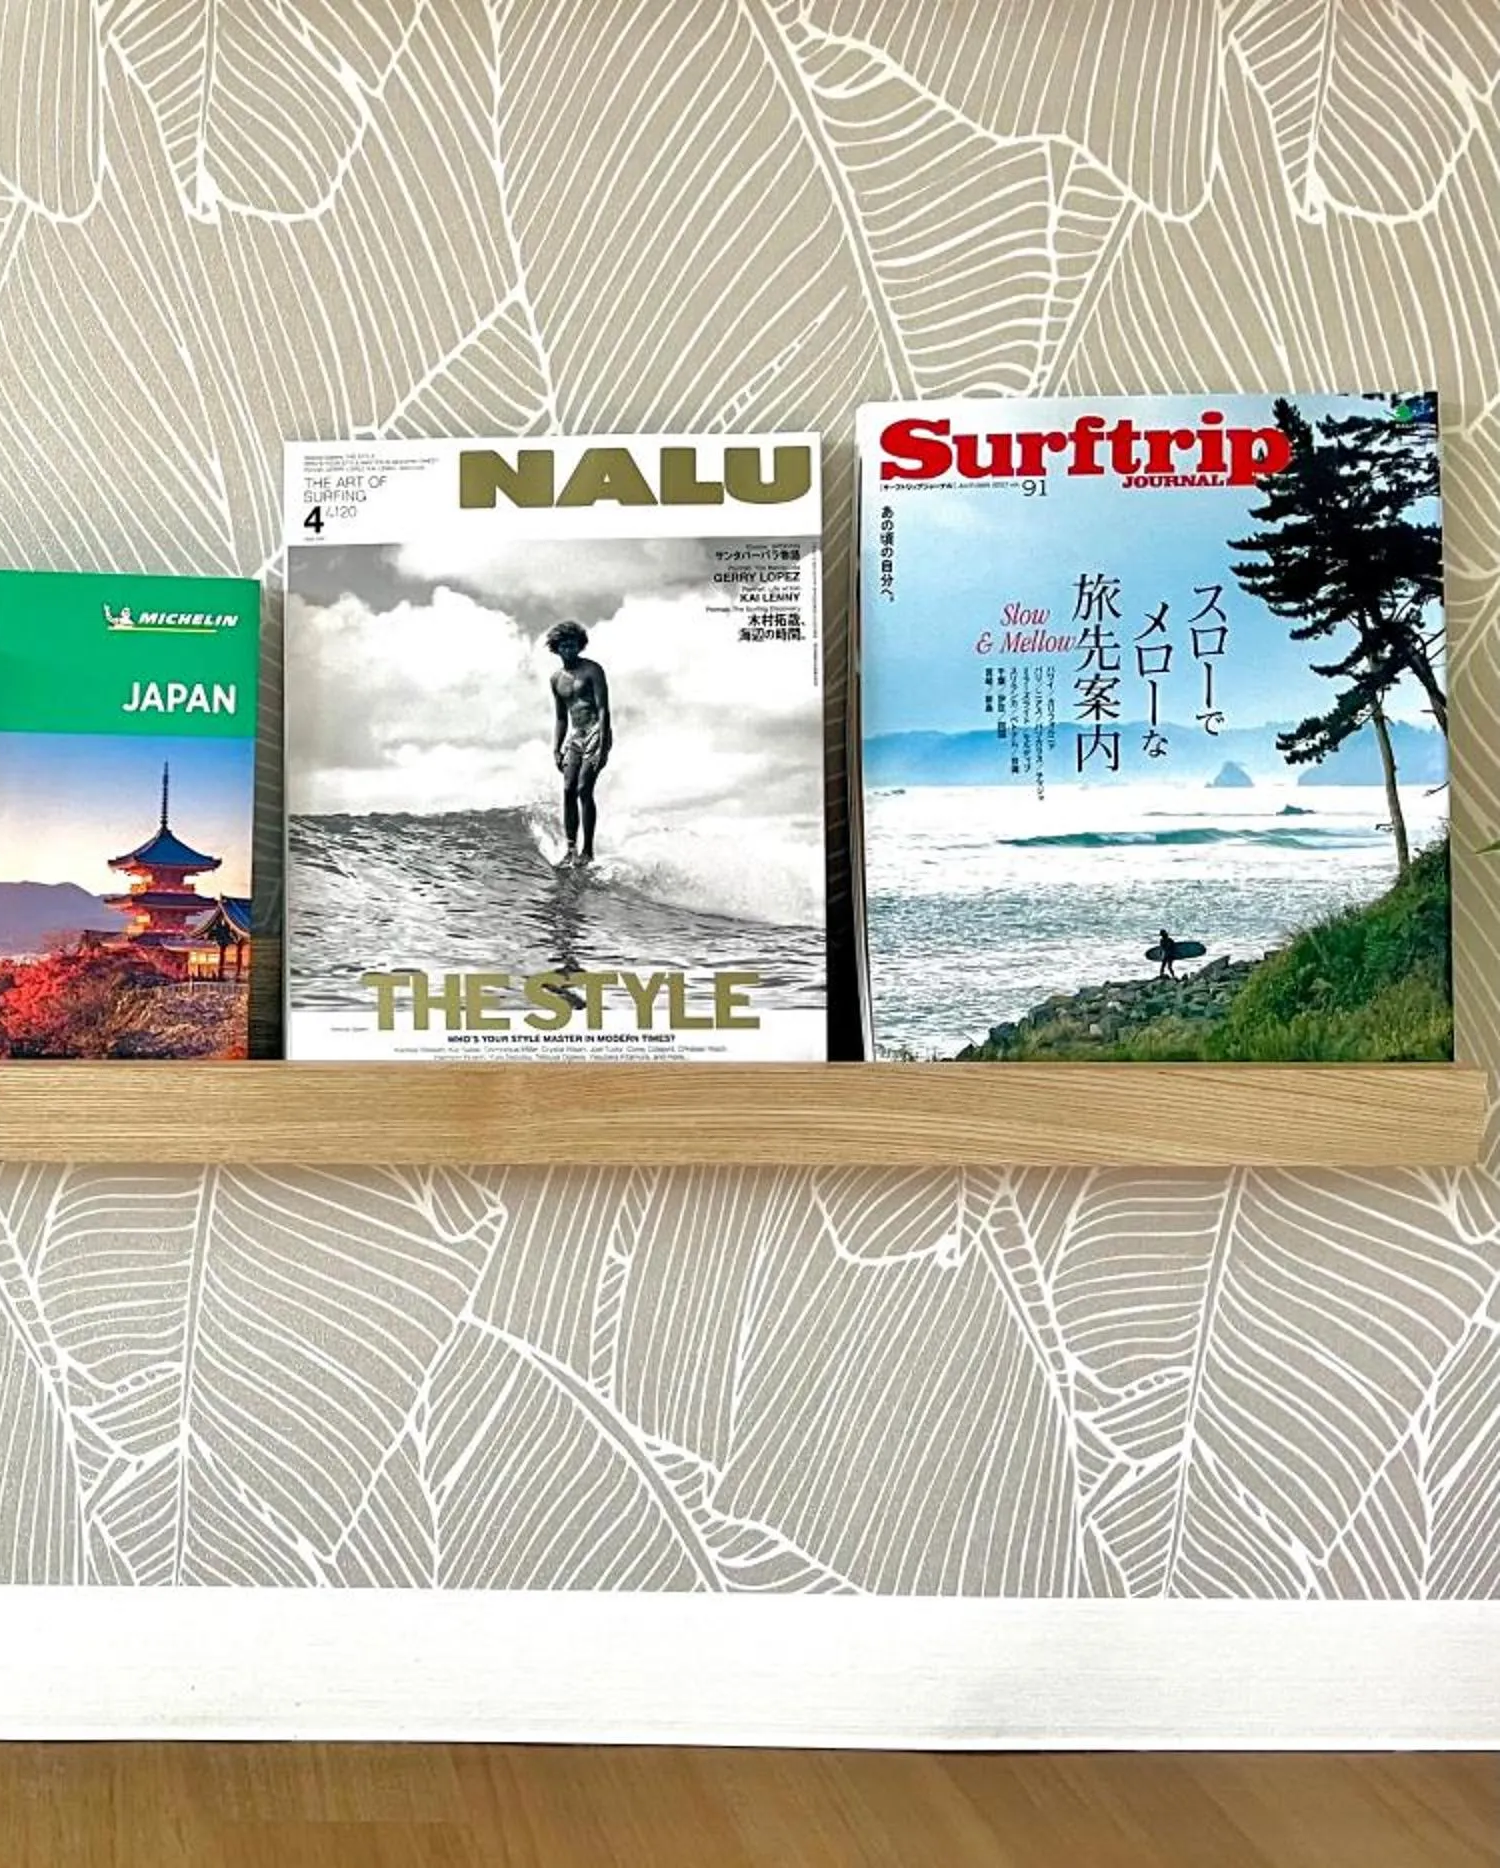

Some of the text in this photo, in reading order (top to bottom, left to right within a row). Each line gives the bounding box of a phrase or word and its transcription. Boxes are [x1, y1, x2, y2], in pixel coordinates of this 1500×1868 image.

[880, 411, 1293, 487] Surftrip
[304, 475, 388, 489] THE ART OF
[459, 446, 812, 508] NALU
[1021, 479, 1047, 497] 91
[1121, 475, 1225, 488] JOURNAL
[303, 489, 367, 503] SURFING
[303, 505, 325, 534] 4
[713, 571, 801, 583] GERRY LOPEZ
[740, 592, 800, 602] KAI LENNY
[138, 611, 238, 627] MICHELIN
[1000, 602, 1051, 626] Slow
[975, 629, 1076, 655] & Mellow
[1071, 573, 1123, 773] 旅先案内
[1187, 584, 1230, 737] スローで
[1133, 601, 1174, 758] メローな
[122, 681, 237, 714] JAPAN
[362, 971, 761, 1031] THE STYLE
[447, 1034, 676, 1043] WHO'S YOUR STYLE MASTER IN MODERN TIMES?
